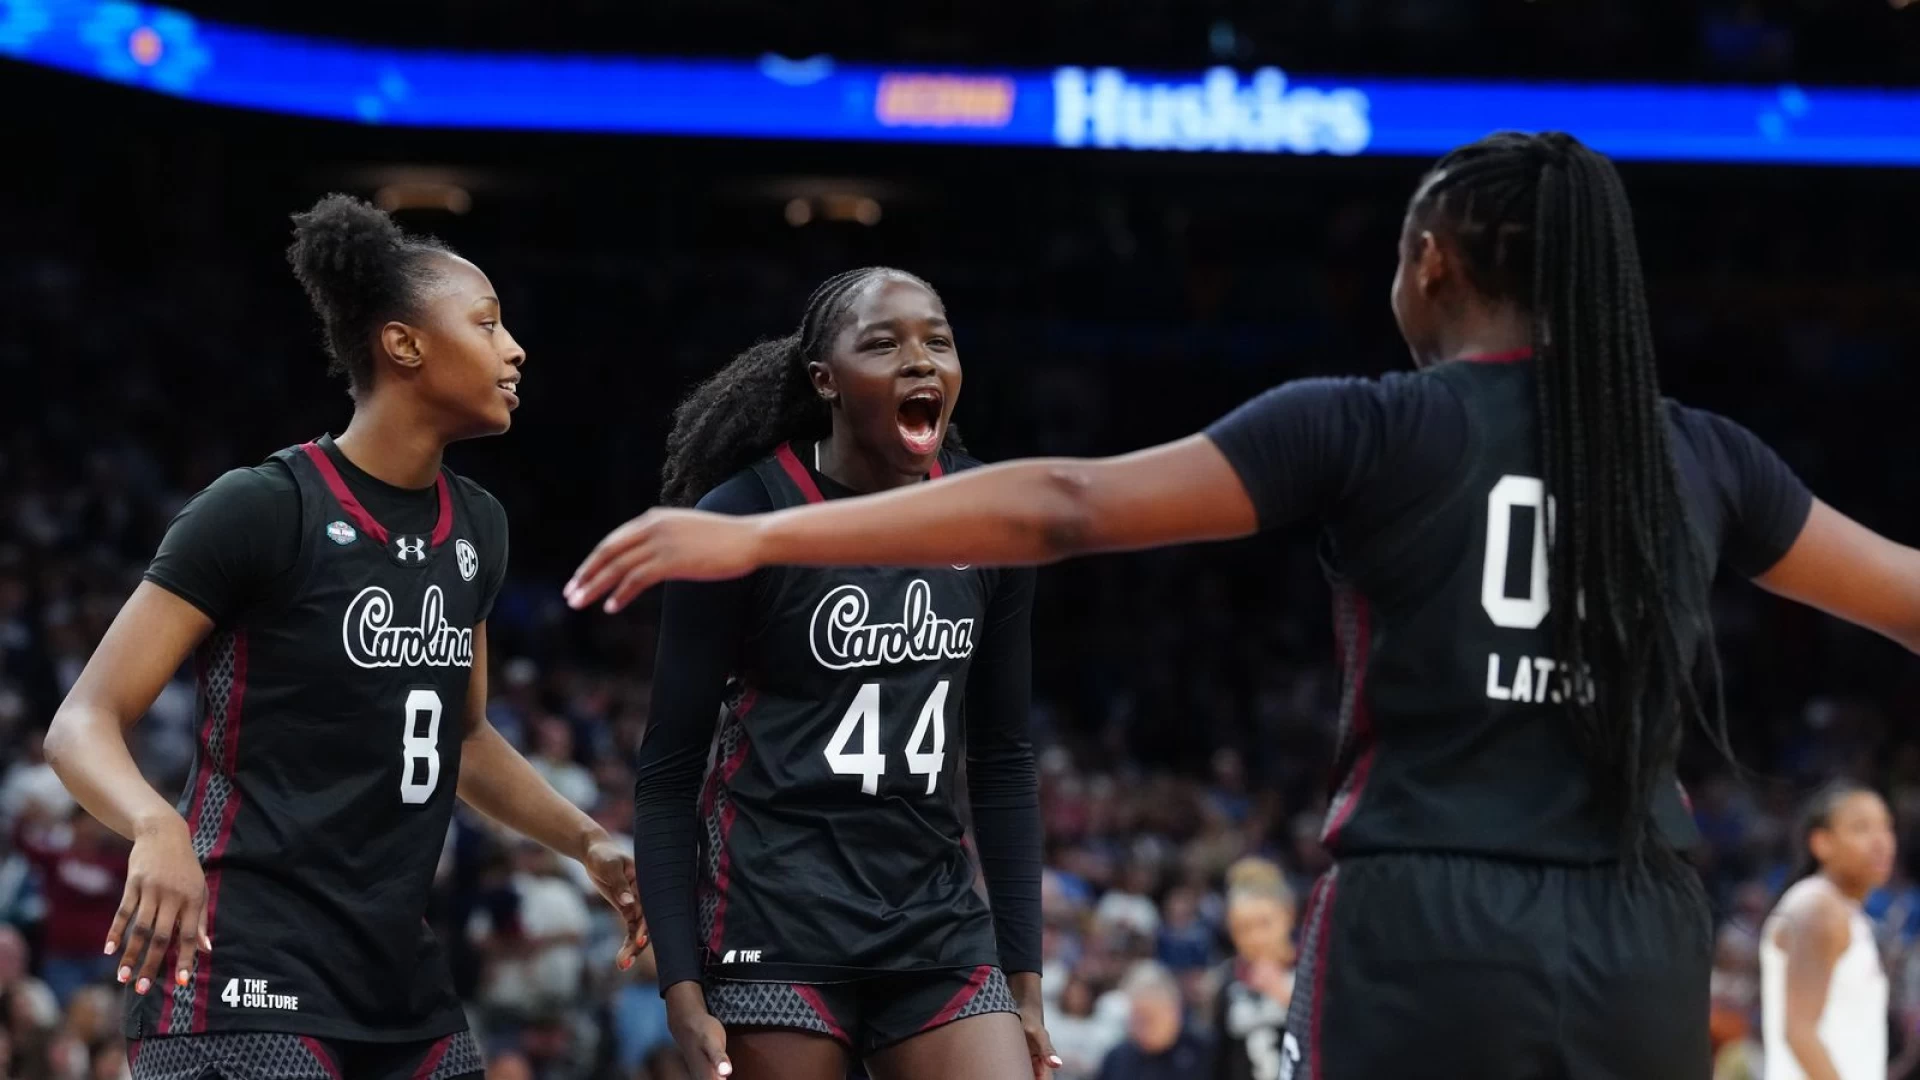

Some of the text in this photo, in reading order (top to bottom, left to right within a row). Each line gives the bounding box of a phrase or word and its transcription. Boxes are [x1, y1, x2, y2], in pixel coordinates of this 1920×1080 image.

[1053, 65, 1371, 156] Huskies
[1481, 474, 1556, 629] 0
[343, 585, 473, 668] Carolina
[810, 579, 974, 670] Carolina
[401, 690, 442, 804] 8
[823, 681, 949, 795] 44
[221, 978, 268, 1008] 4 THE
[243, 994, 298, 1010] CULTURE
[740, 950, 762, 963] THE
